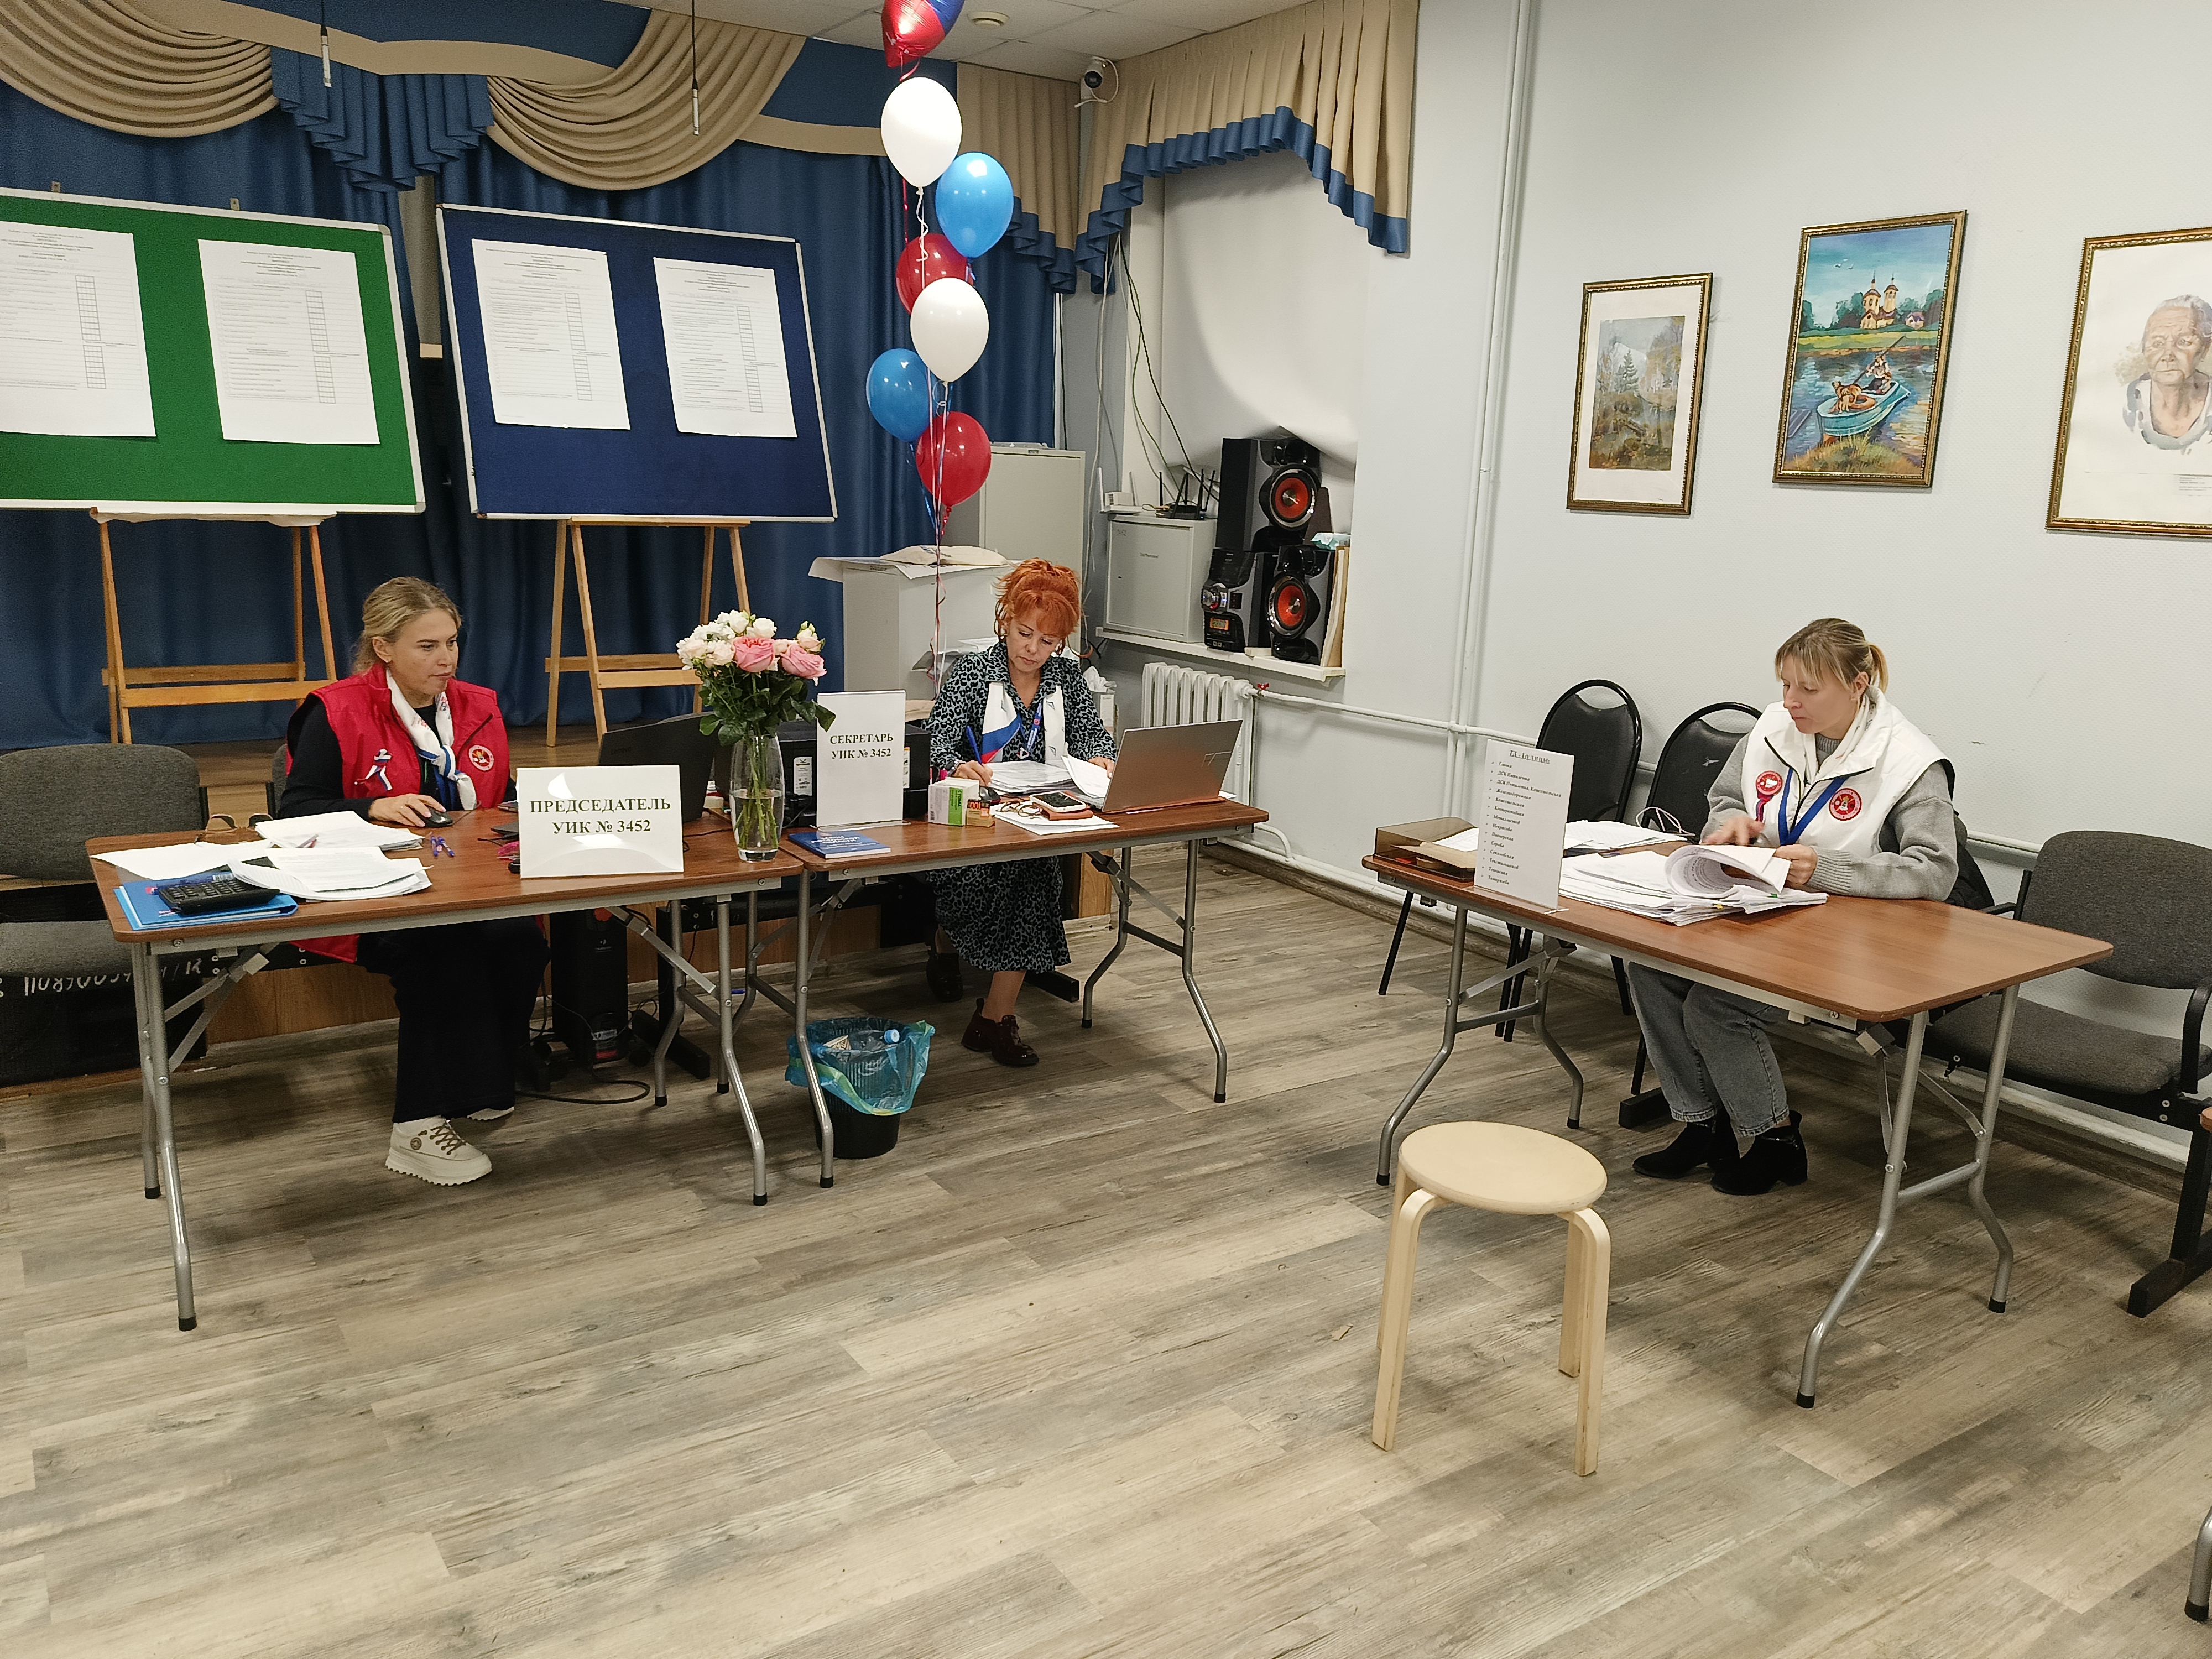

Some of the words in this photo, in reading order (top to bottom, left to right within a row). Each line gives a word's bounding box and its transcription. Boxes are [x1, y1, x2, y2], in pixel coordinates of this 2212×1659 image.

[830, 733, 894, 744] СЕКРЕТАРЬ
[832, 750, 855, 759] УИК
[857, 749, 868, 758] №
[870, 748, 891, 757] 3452
[530, 799, 670, 813] ПРЕДСЕДАТЕЛЬ
[552, 822, 591, 834] УИК
[596, 821, 612, 833] №
[617, 820, 650, 832] 3452
